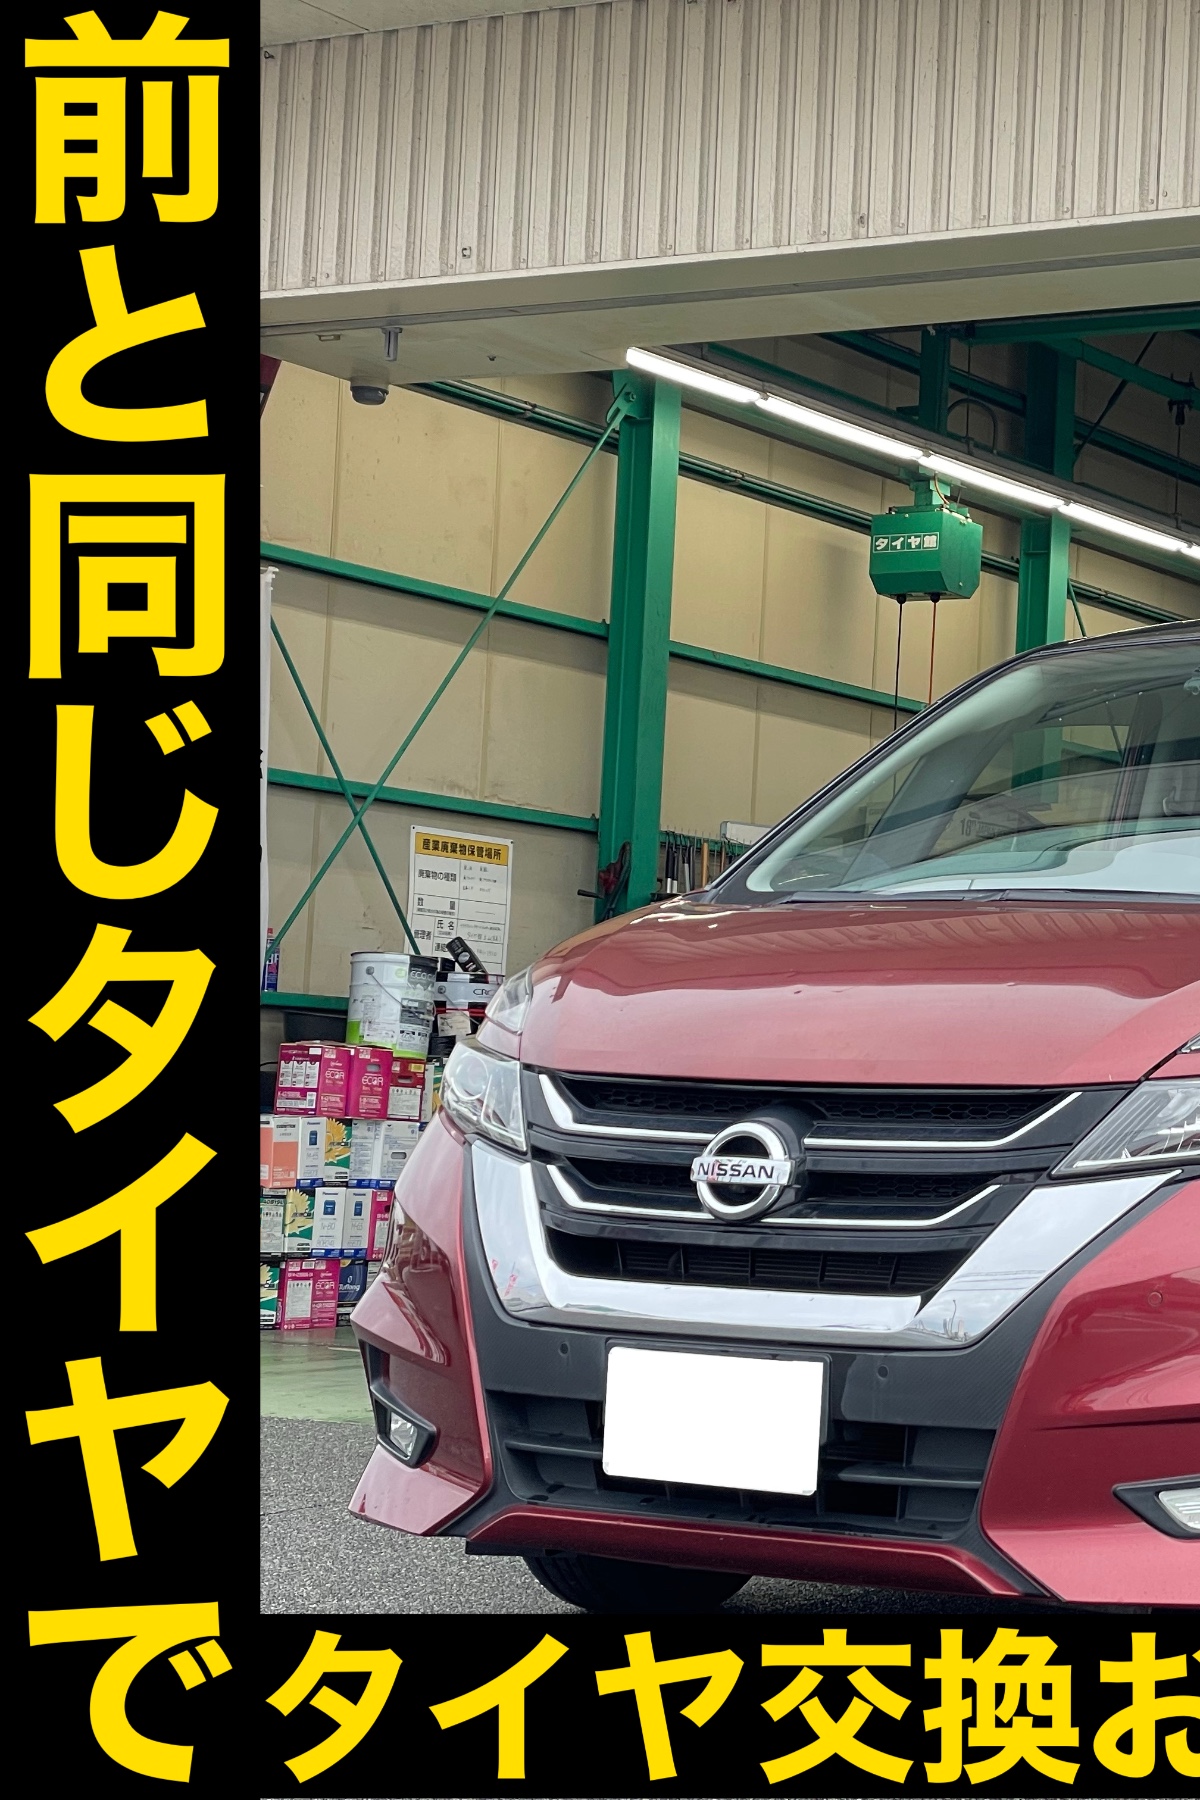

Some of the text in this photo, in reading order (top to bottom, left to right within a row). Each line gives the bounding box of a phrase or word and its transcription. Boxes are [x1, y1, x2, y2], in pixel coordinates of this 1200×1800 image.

[875, 535, 938, 550] タイヤ館
[697, 1162, 775, 1179] NISSAN
